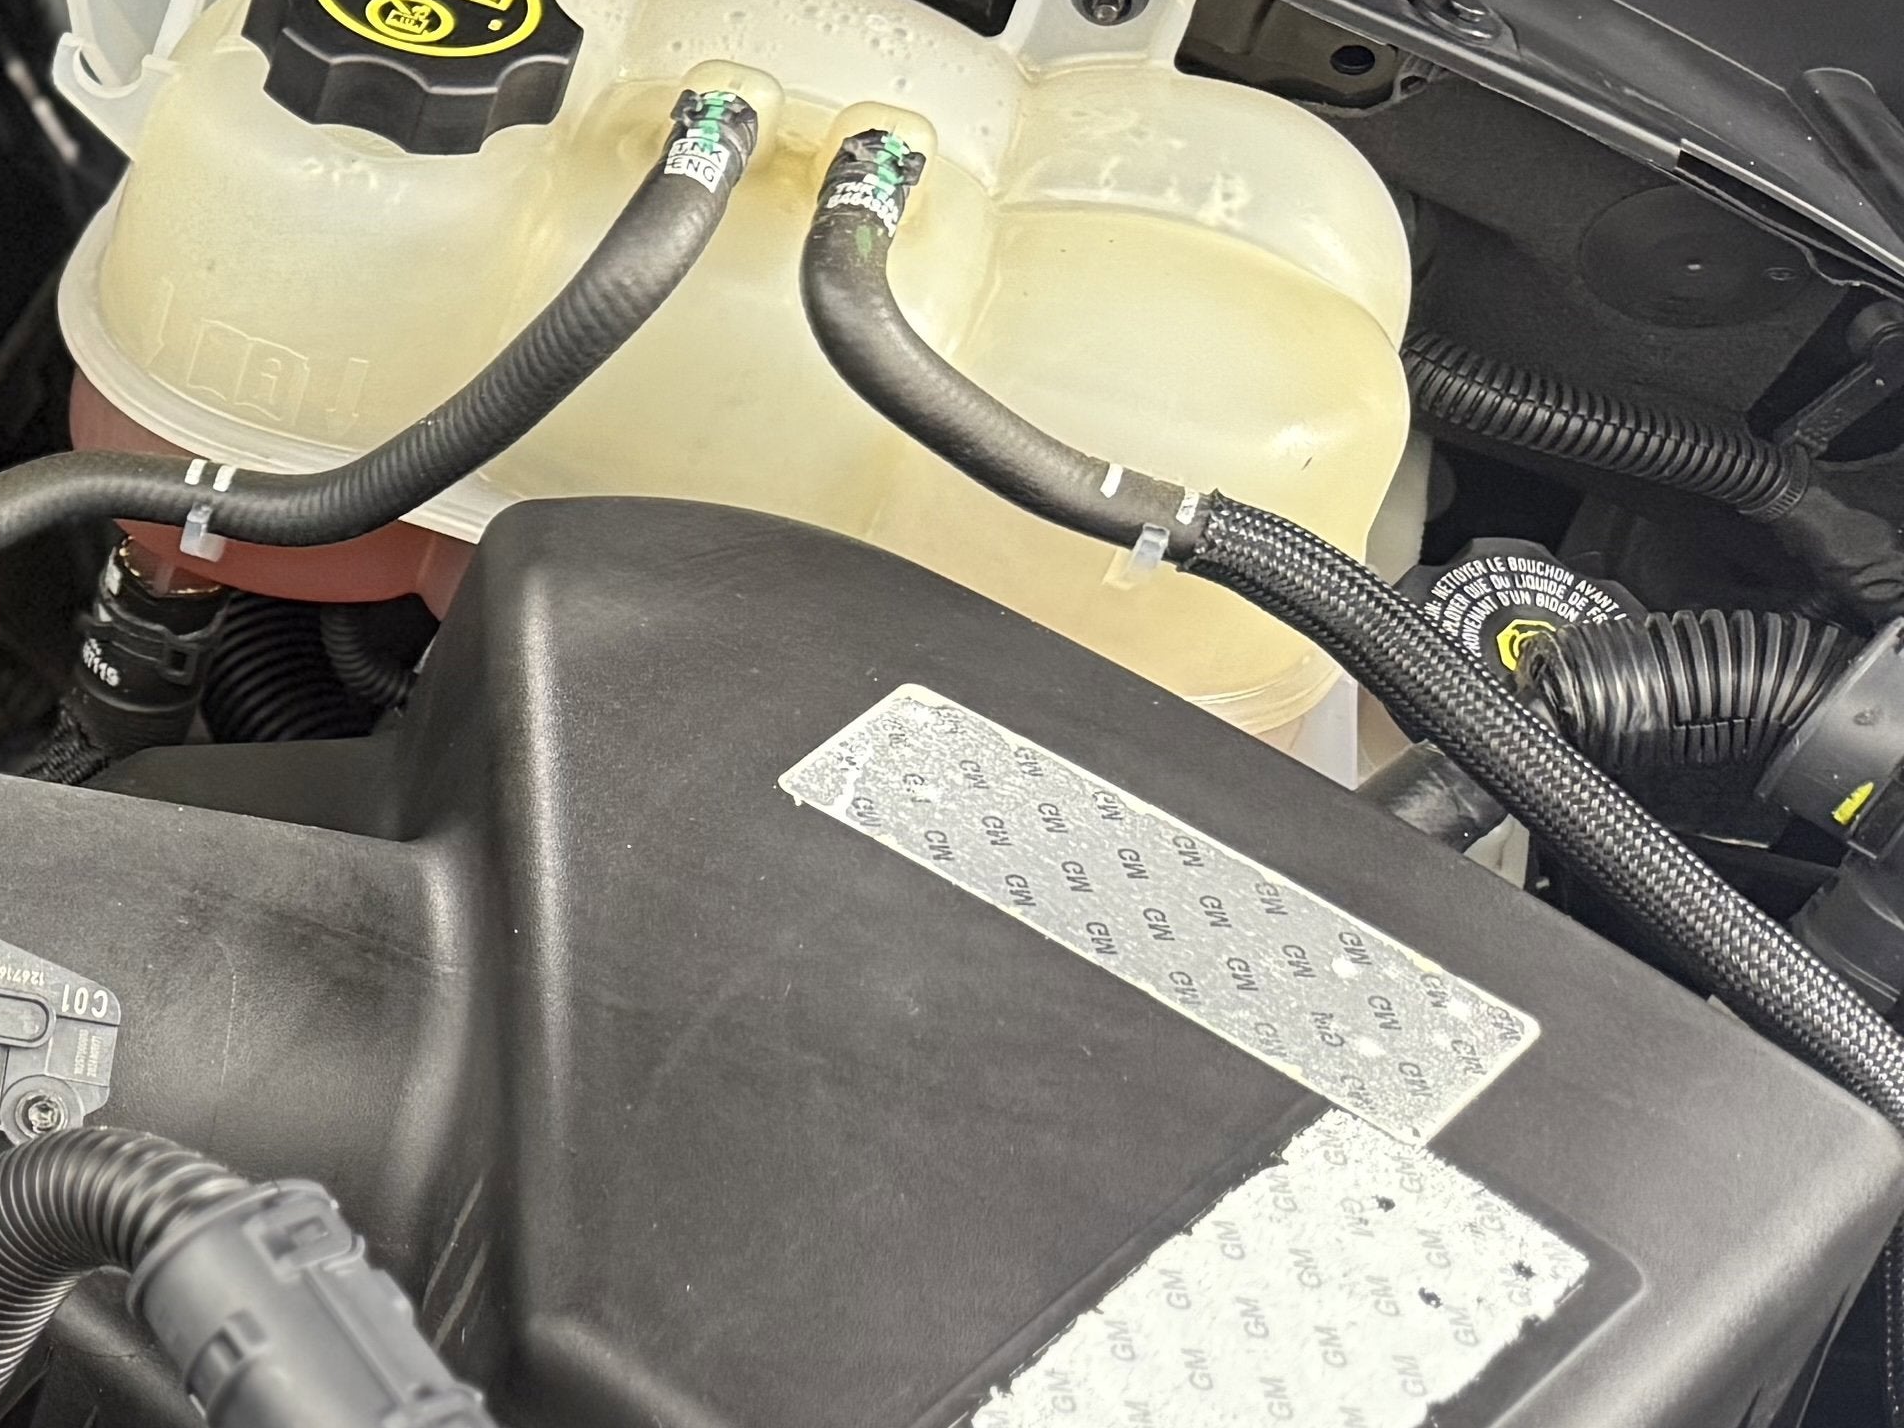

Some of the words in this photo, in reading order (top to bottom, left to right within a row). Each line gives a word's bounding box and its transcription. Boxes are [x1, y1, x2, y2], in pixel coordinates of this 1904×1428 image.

[671, 157, 716, 183] ENG
[1431, 559, 1488, 601] NETTOYER
[1485, 556, 1506, 573] LE
[1507, 556, 1575, 586] BOUCHON
[1575, 579, 1620, 613] AVANT
[1442, 592, 1472, 637] PLOYER
[1463, 577, 1493, 600] QUE
[1489, 573, 1511, 590] DU
[1514, 573, 1567, 600] LIQUIDE
[1567, 591, 1589, 611] DE
[1496, 589, 1532, 607] D'UN
[1535, 592, 1580, 623] BIDON
[61, 983, 109, 1018] C01
[1289, 1248, 1322, 1289] GM
[1417, 1228, 1452, 1269] GM
[1158, 1268, 1191, 1310] GM
[1365, 1275, 1400, 1317] GM
[1236, 1297, 1269, 1339] GM
[1104, 1320, 1136, 1362] GM
[1313, 1325, 1347, 1368] GM
[1181, 1348, 1213, 1391] GM
[1393, 1355, 1428, 1397] GM
[1259, 1376, 1293, 1420] GM
